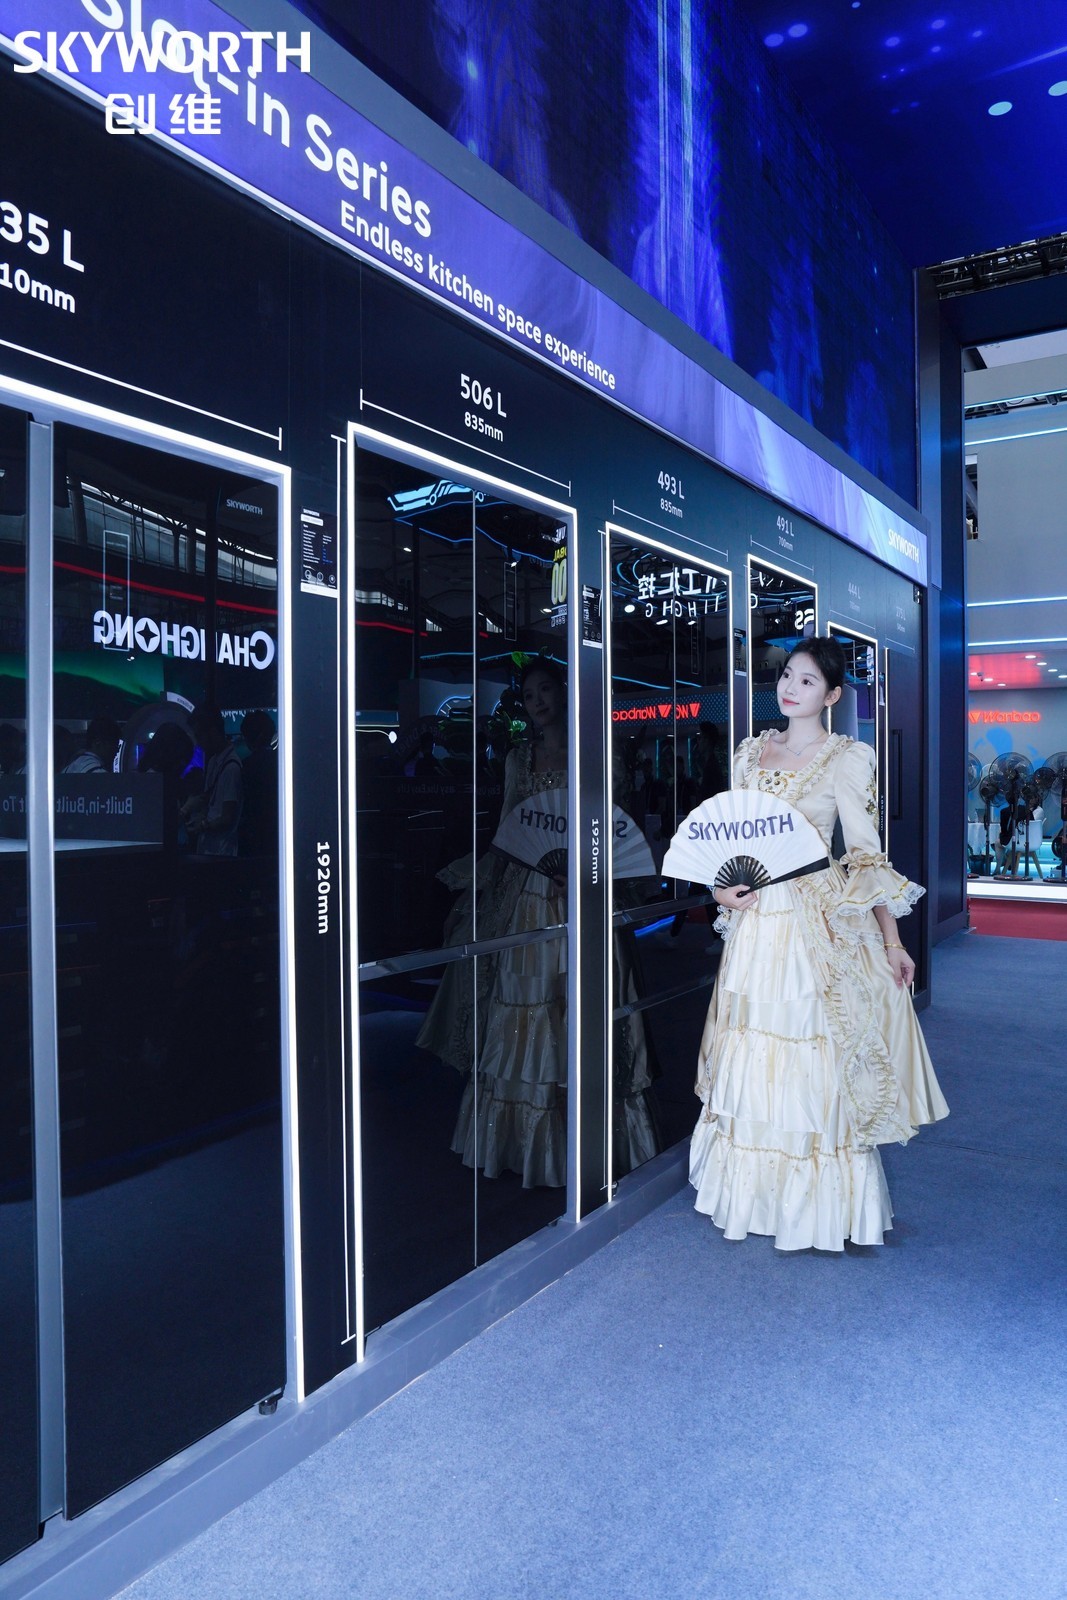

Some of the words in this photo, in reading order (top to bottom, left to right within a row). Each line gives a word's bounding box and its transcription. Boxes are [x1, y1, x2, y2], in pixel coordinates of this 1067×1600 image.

[305, 113, 432, 239] Series
[63, 229, 86, 273] L
[340, 200, 424, 273] Endless
[428, 254, 494, 316] kitchen
[497, 303, 542, 344] space
[544, 333, 616, 390] experience
[460, 373, 493, 411] 506
[497, 392, 507, 418] L
[464, 411, 504, 442] 835mm
[657, 470, 677, 497] 493
[226, 498, 263, 516] SKYWORTH
[660, 498, 683, 518] 835mm
[776, 515, 789, 535] 491
[888, 528, 920, 564] SKYWORTH
[983, 709, 1041, 724] Wanbao
[687, 812, 794, 841] SKYWORTH
[591, 818, 600, 884] 1920mm
[316, 841, 331, 934] 1920mm
